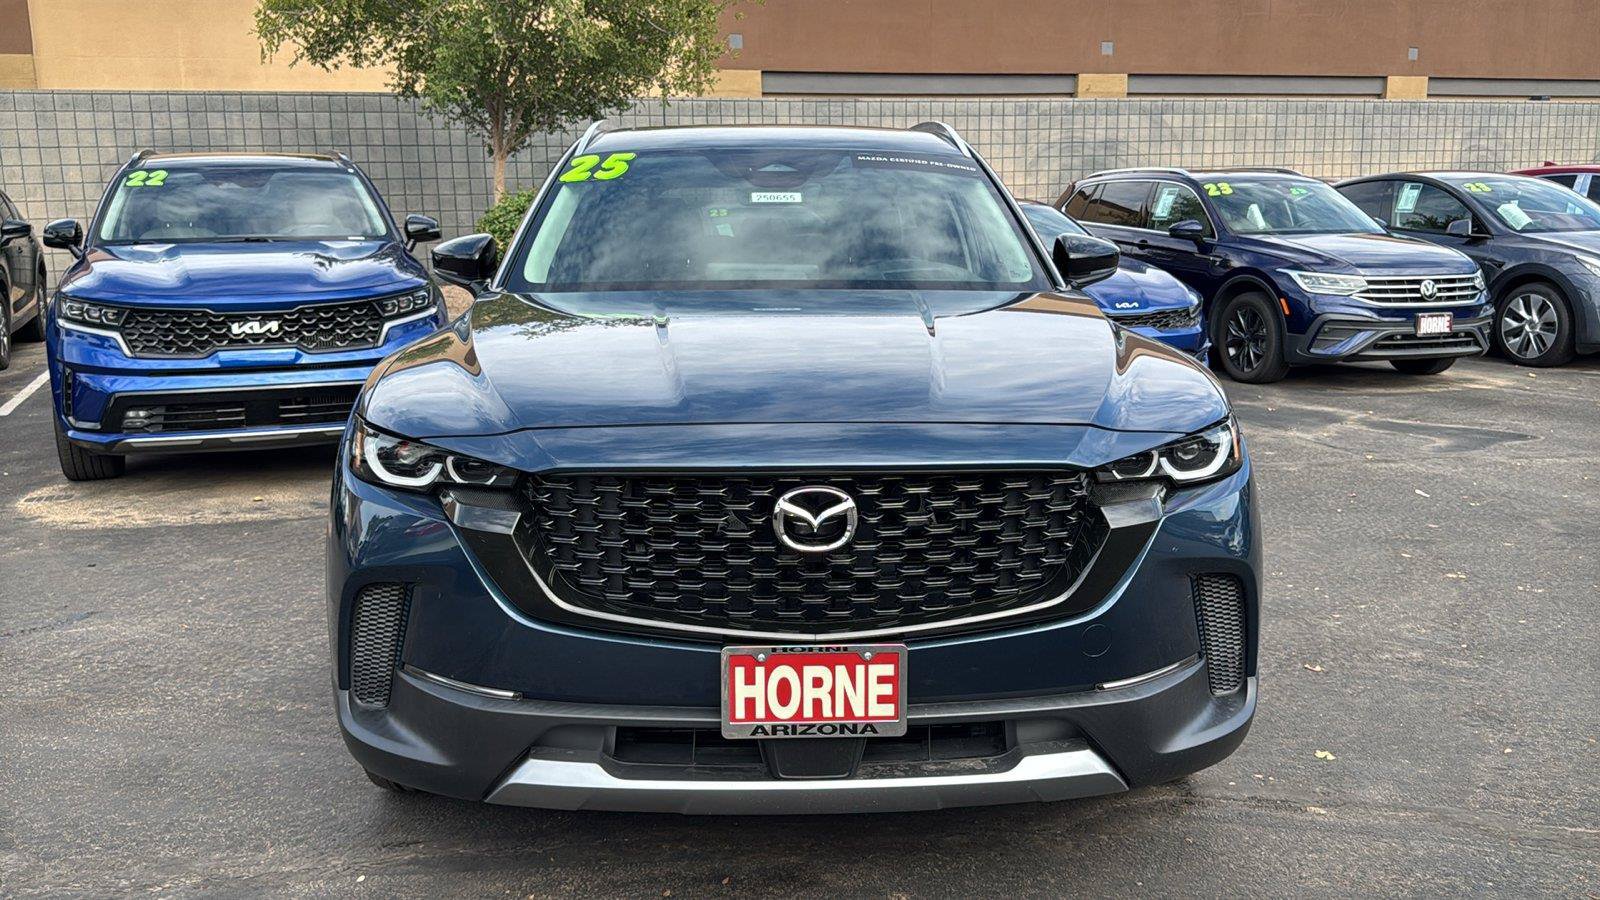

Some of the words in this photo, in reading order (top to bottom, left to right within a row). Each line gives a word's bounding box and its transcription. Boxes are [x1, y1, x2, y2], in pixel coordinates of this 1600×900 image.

[559, 152, 637, 182] 25
[125, 169, 169, 186] 22
[756, 193, 797, 202] 250655
[1204, 182, 1233, 196] 23
[1420, 316, 1451, 333] HORNE
[734, 664, 895, 719] HORNE
[750, 723, 879, 736] ARIZONA
